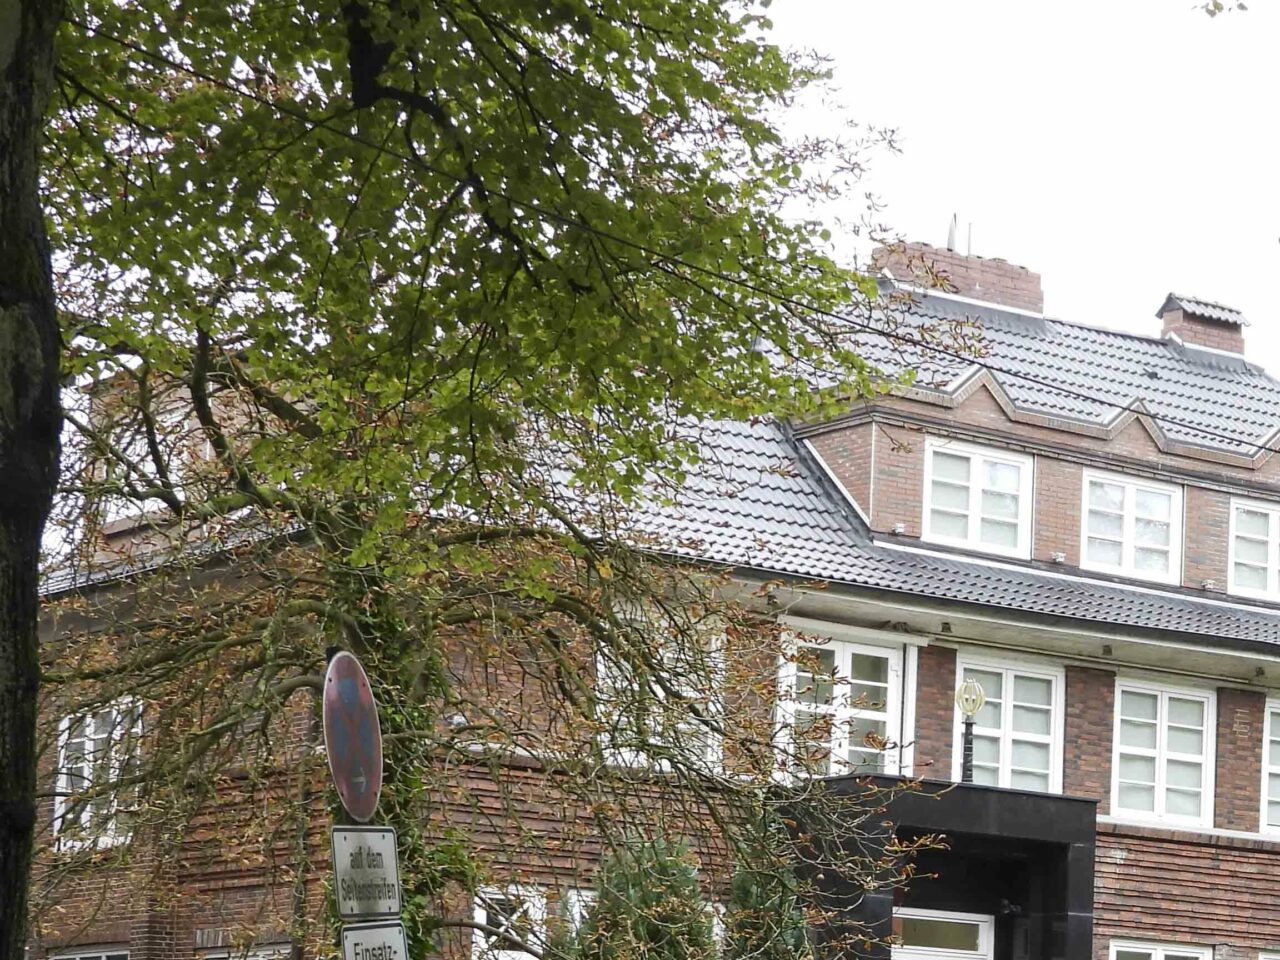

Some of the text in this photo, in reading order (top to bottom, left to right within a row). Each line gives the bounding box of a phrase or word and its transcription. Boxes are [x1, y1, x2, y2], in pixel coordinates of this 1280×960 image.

[349, 845, 384, 869] auf dem
[340, 876, 397, 901] Seitenstreifen
